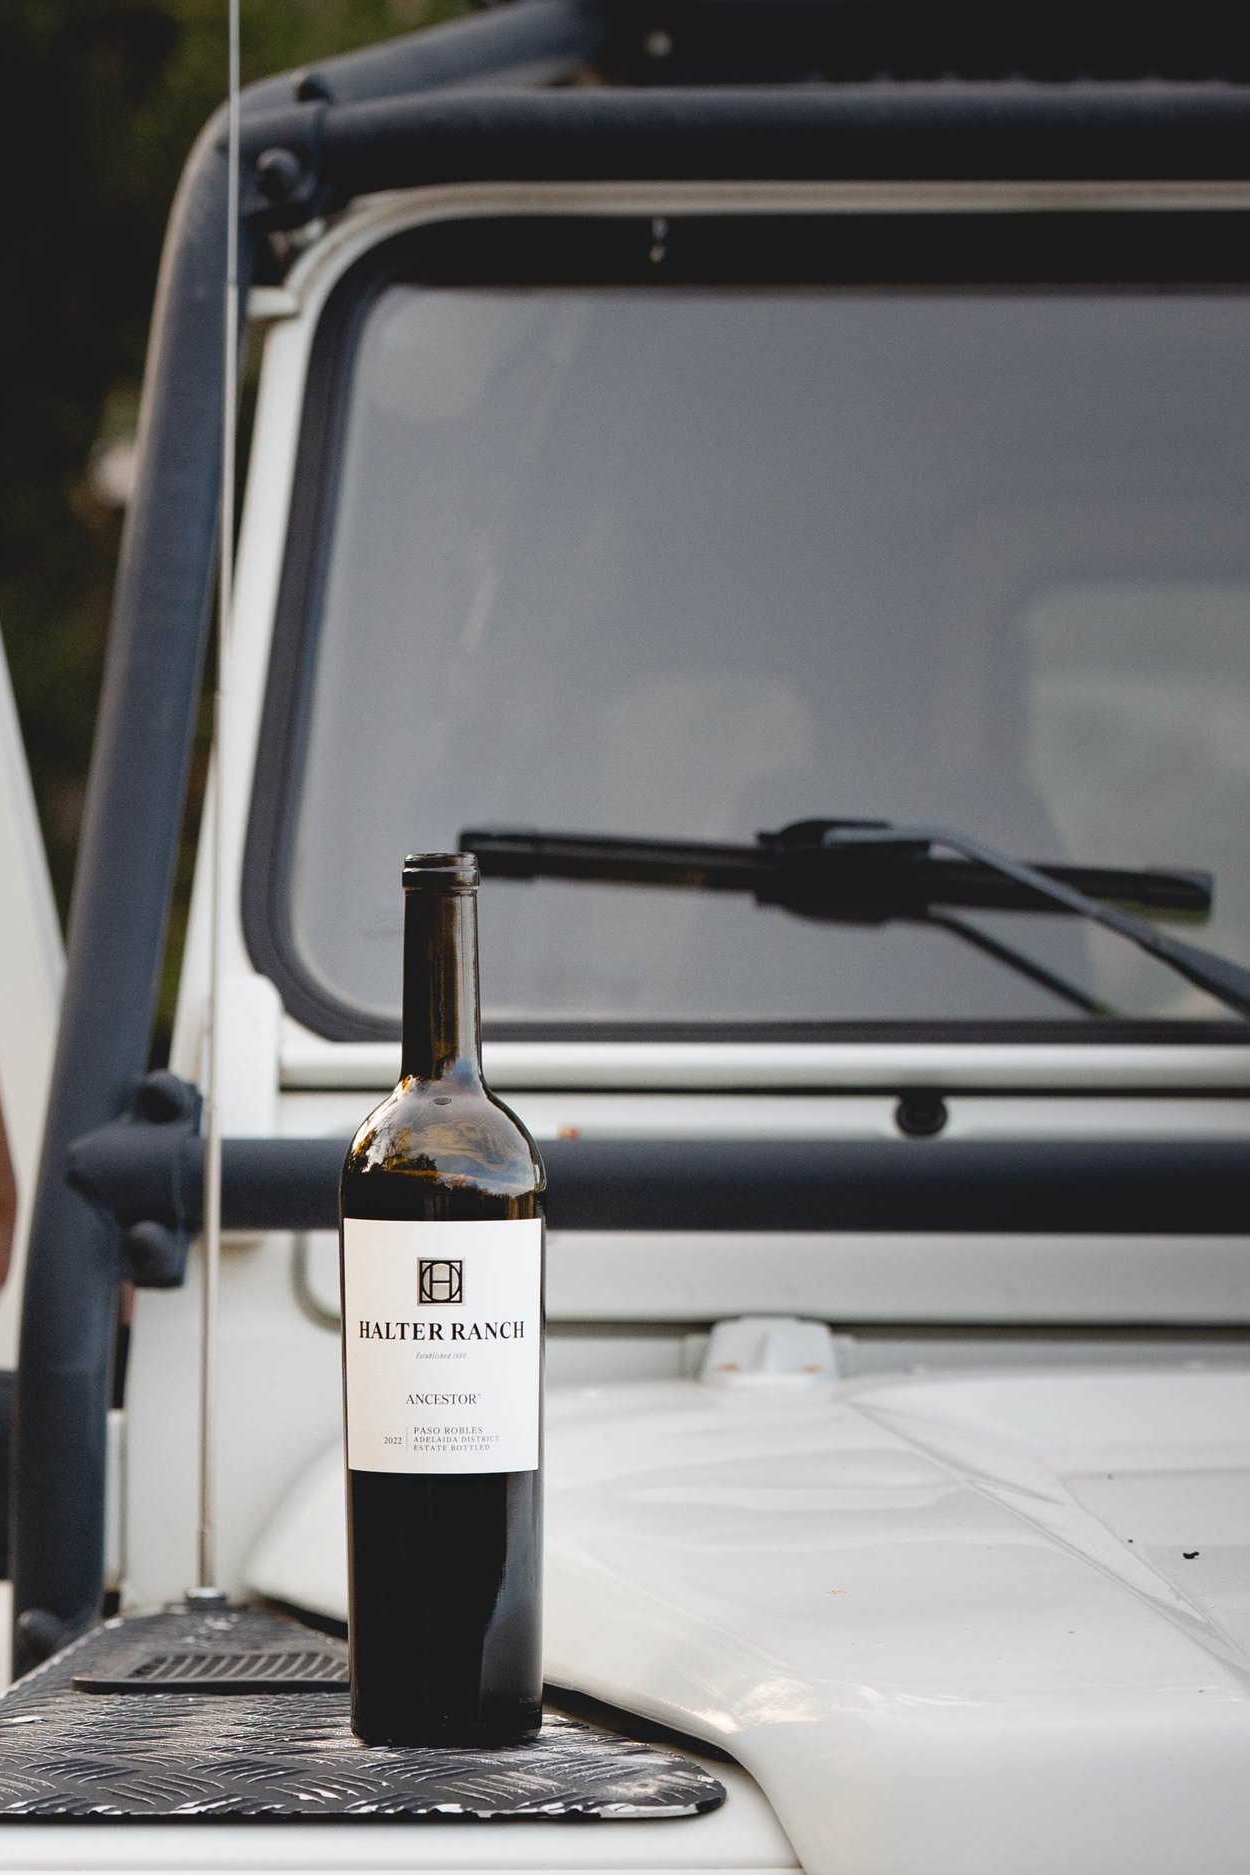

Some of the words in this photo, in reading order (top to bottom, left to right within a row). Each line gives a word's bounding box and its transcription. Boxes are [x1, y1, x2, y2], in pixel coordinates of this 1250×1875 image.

[359, 1320, 444, 1340] HALTER
[451, 1320, 525, 1340] RANCH
[415, 1351, 451, 1360] Established
[383, 1436, 403, 1445] 2022
[461, 1435, 501, 1443] DISTRICT
